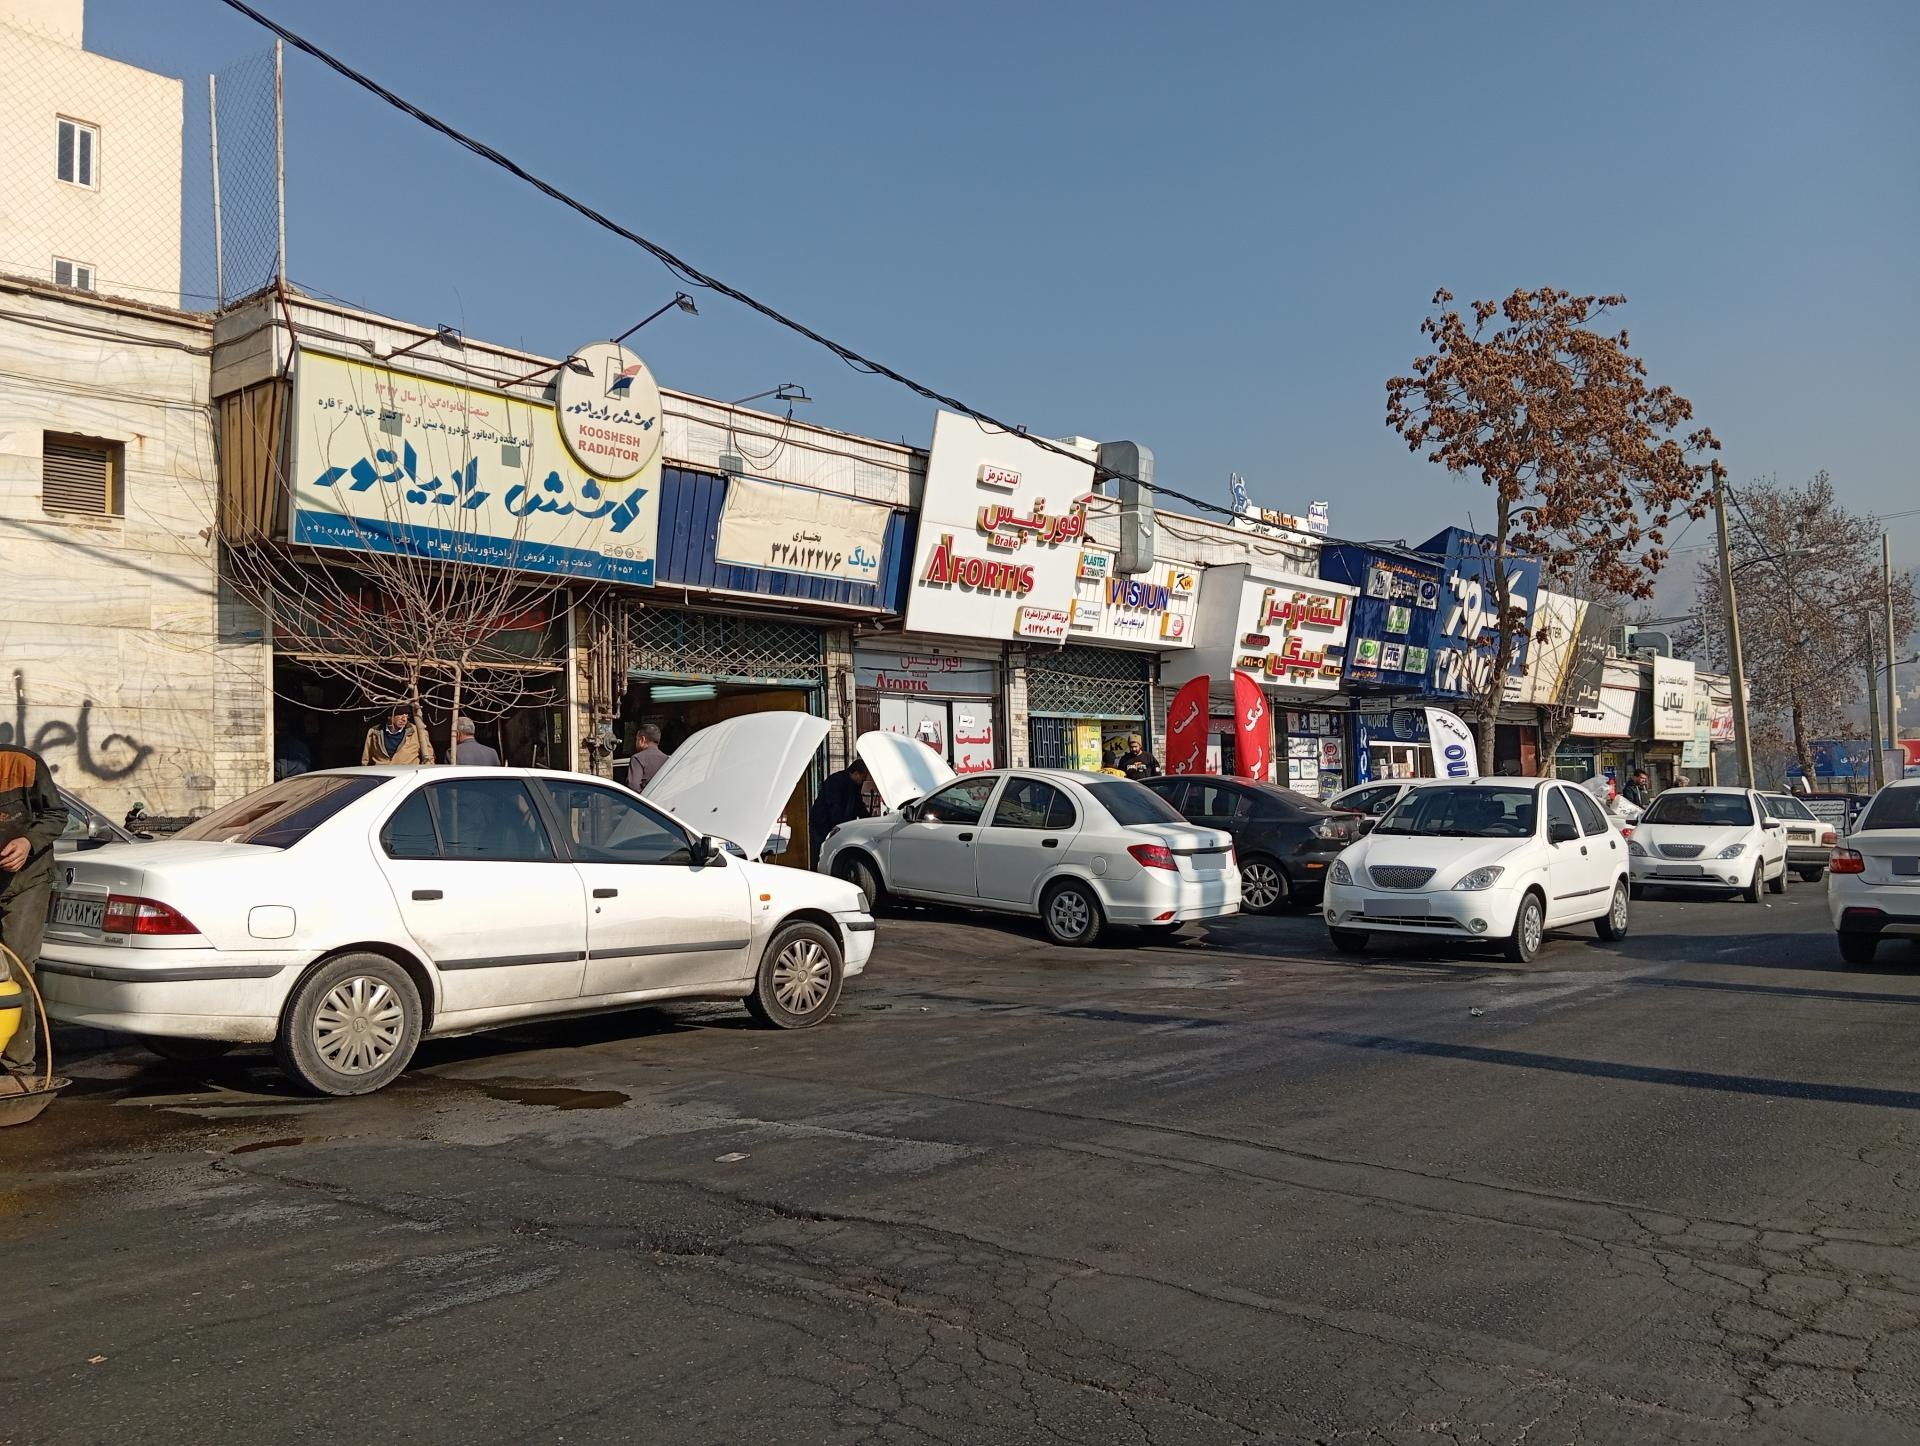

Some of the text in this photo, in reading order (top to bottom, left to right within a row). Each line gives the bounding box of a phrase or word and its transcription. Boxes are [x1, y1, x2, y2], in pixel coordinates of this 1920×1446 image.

[318, 397, 335, 410] قاره
[400, 390, 417, 402] سال
[428, 398, 466, 413] خانوادگی
[343, 404, 353, 414] در
[566, 399, 656, 431] کوشش رادیاتور
[448, 425, 470, 437] خودرو
[579, 424, 641, 448] KOOSHESH
[578, 440, 640, 462] RADIATOR
[312, 438, 491, 510] رادیاتور
[985, 469, 1019, 485] لنت ترمز
[505, 470, 648, 533] کوشش
[994, 535, 1019, 549] Brake
[523, 552, 545, 563] فروش
[847, 546, 877, 572] دیاگ
[926, 535, 1035, 594] AFORTIS
[1265, 587, 1348, 630] لنت ترمز
[1173, 700, 1200, 734] لنت
[955, 727, 992, 745] لنت
